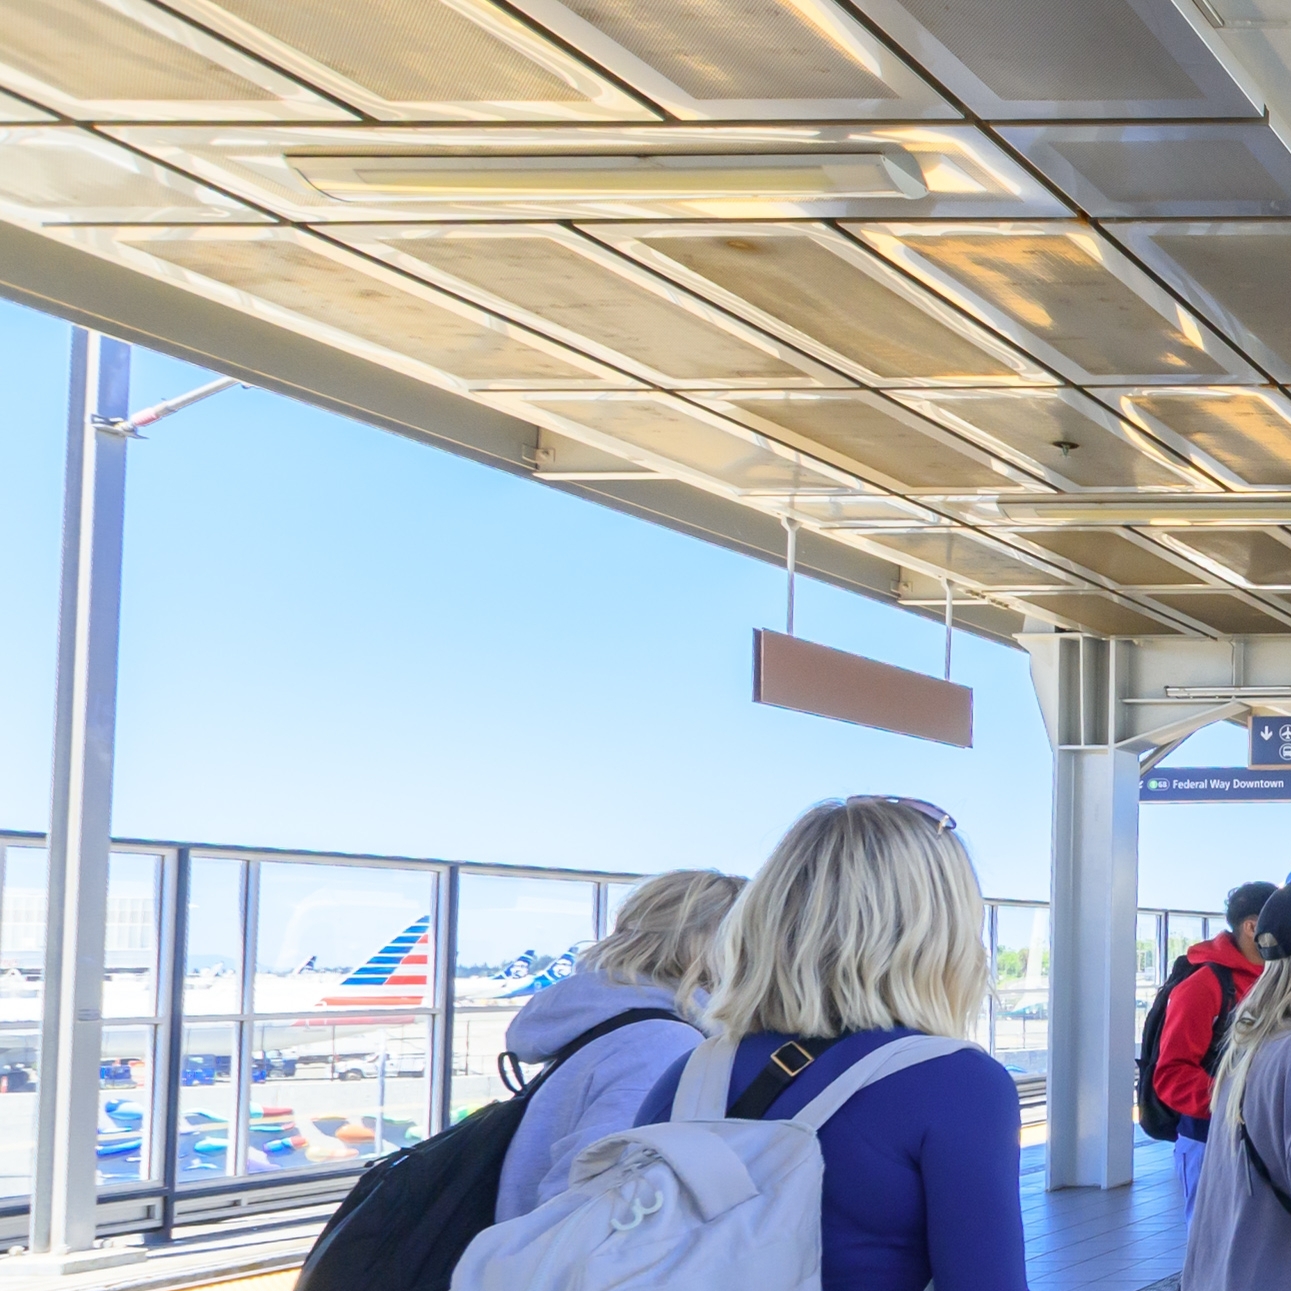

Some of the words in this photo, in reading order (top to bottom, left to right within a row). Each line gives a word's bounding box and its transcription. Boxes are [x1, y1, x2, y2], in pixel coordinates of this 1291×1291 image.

[1172, 779, 1208, 790] Federal
[1209, 779, 1230, 791] Way
[1233, 778, 1284, 789] Downtown
